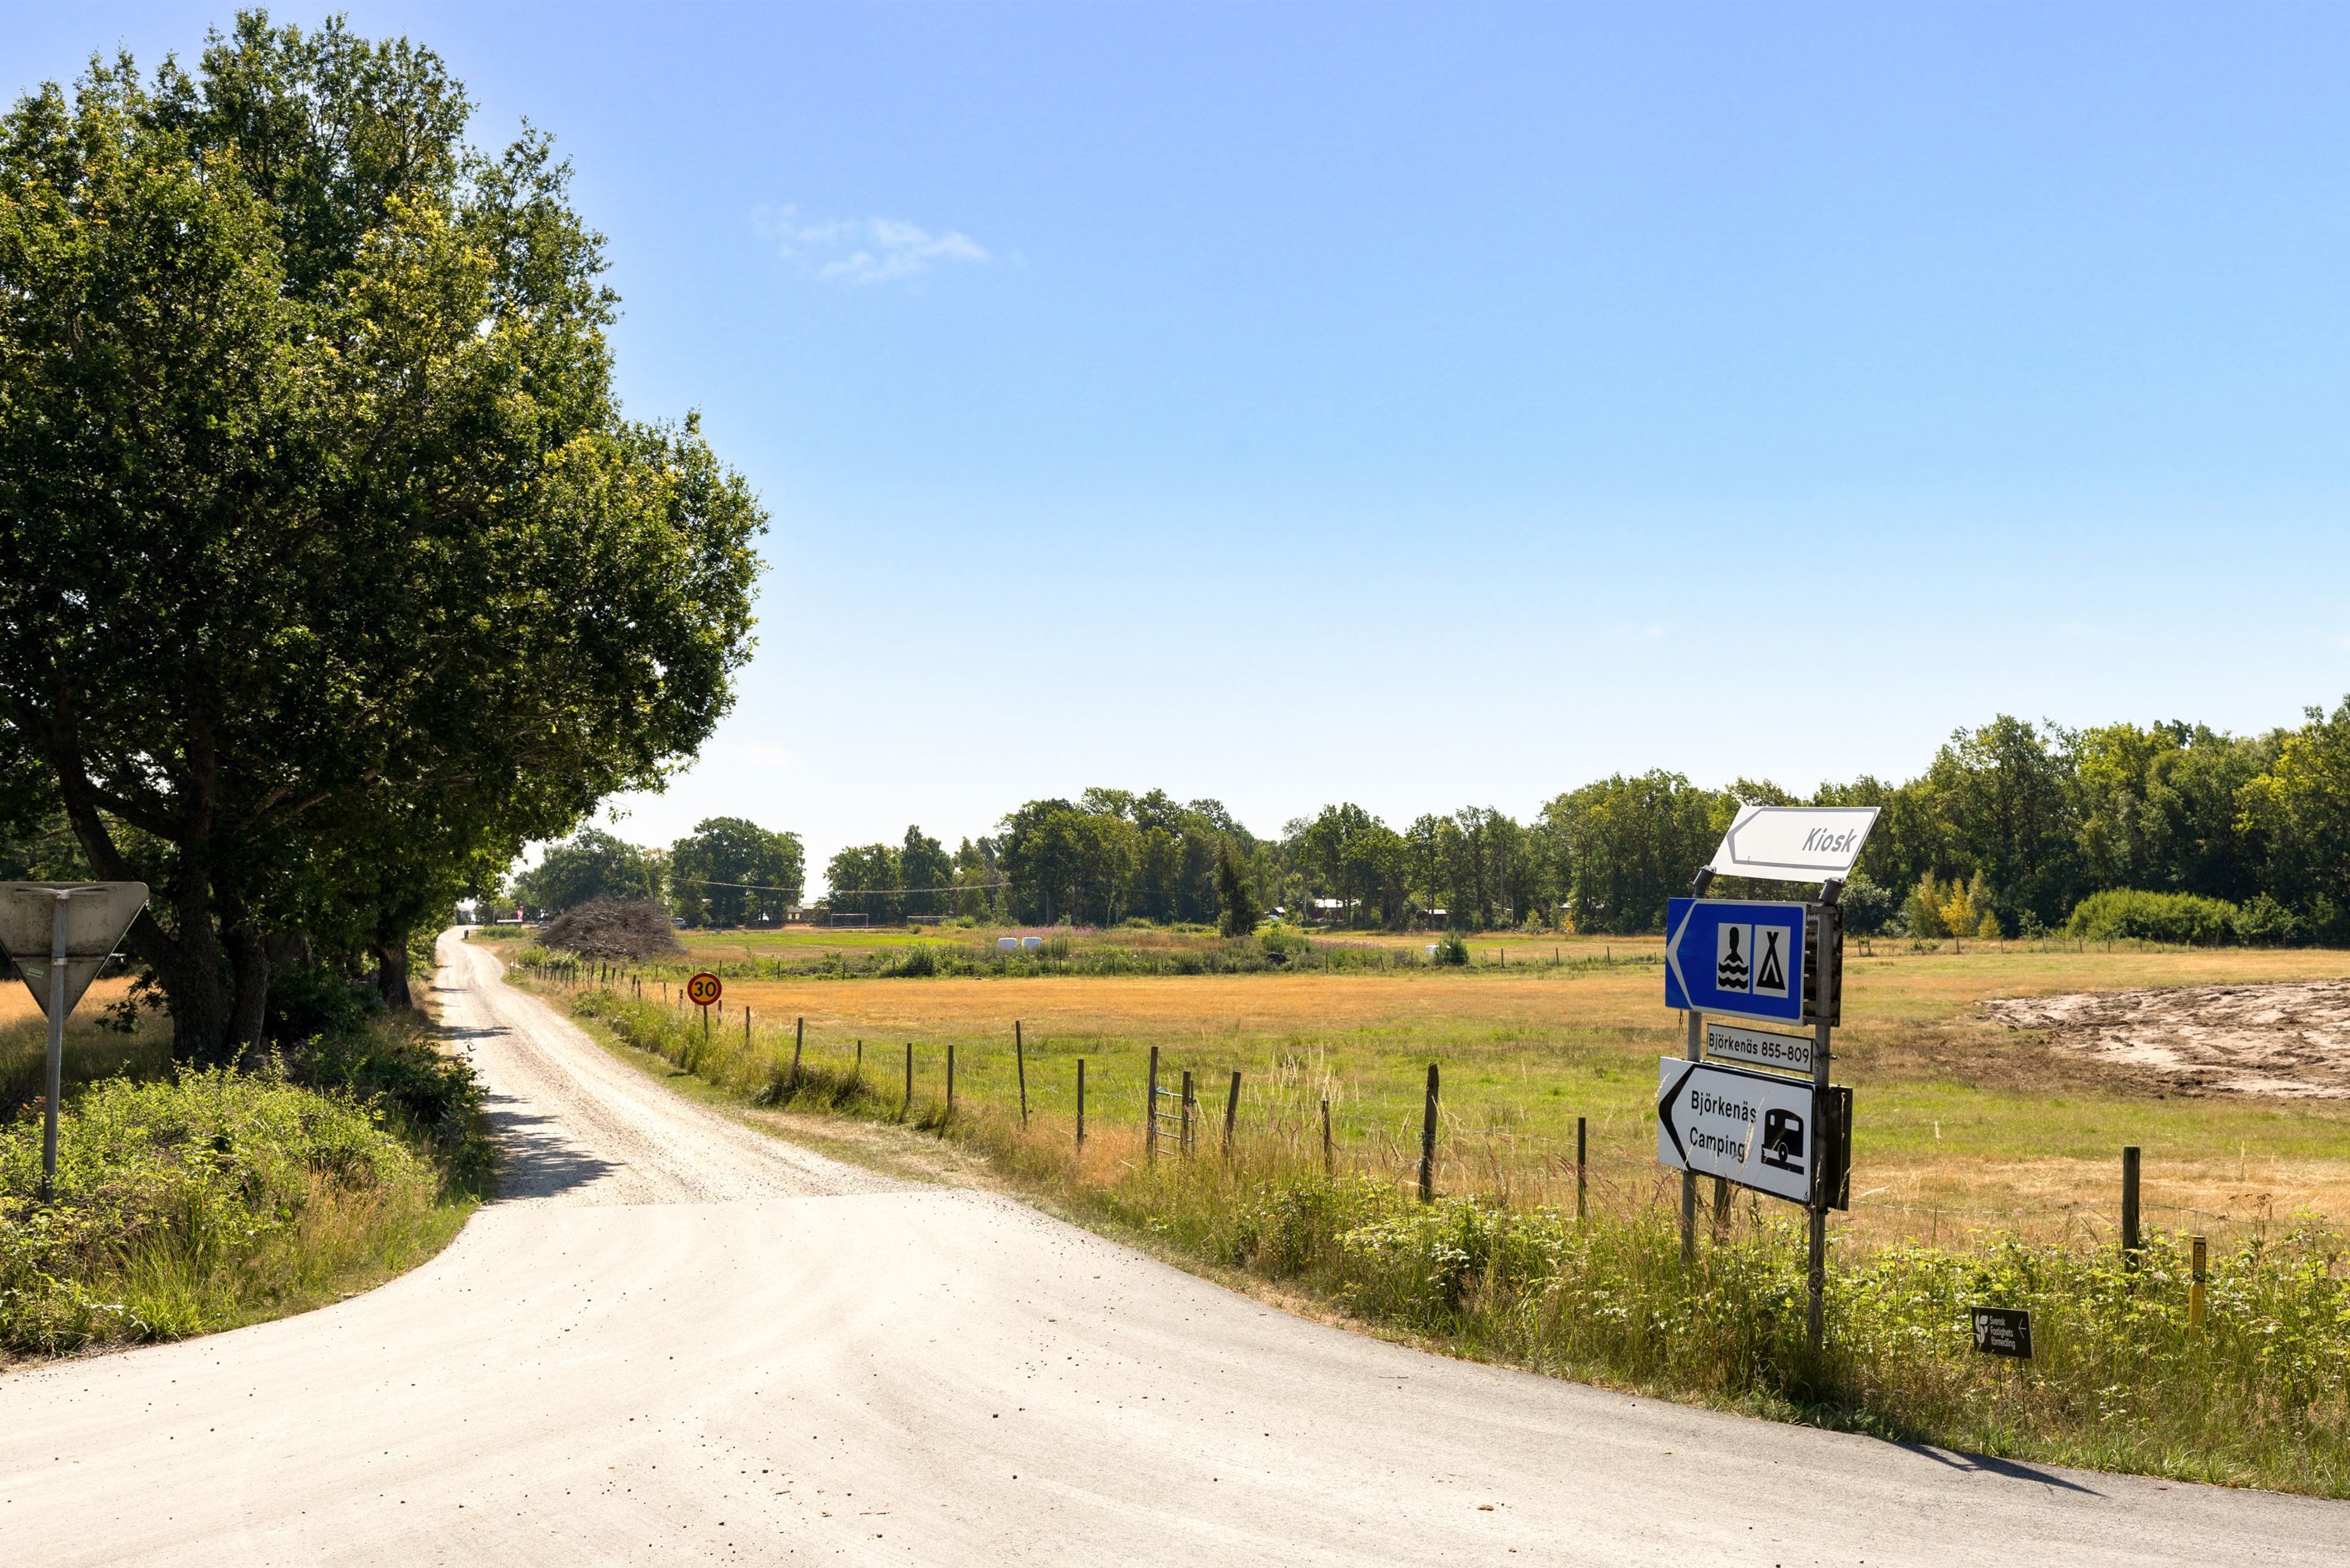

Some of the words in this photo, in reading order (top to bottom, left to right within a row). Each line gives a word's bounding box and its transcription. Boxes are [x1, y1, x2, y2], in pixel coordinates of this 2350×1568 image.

[1802, 827, 1858, 852] Kiosk
[694, 981, 717, 997] 30
[1709, 1033, 1758, 1055] Björkenäs
[1762, 1041, 1809, 1063] 855-809
[1692, 1090, 1757, 1123] Björkenäs
[1690, 1126, 1745, 1163] Camping
[1989, 1316, 2006, 1326] Svensk
